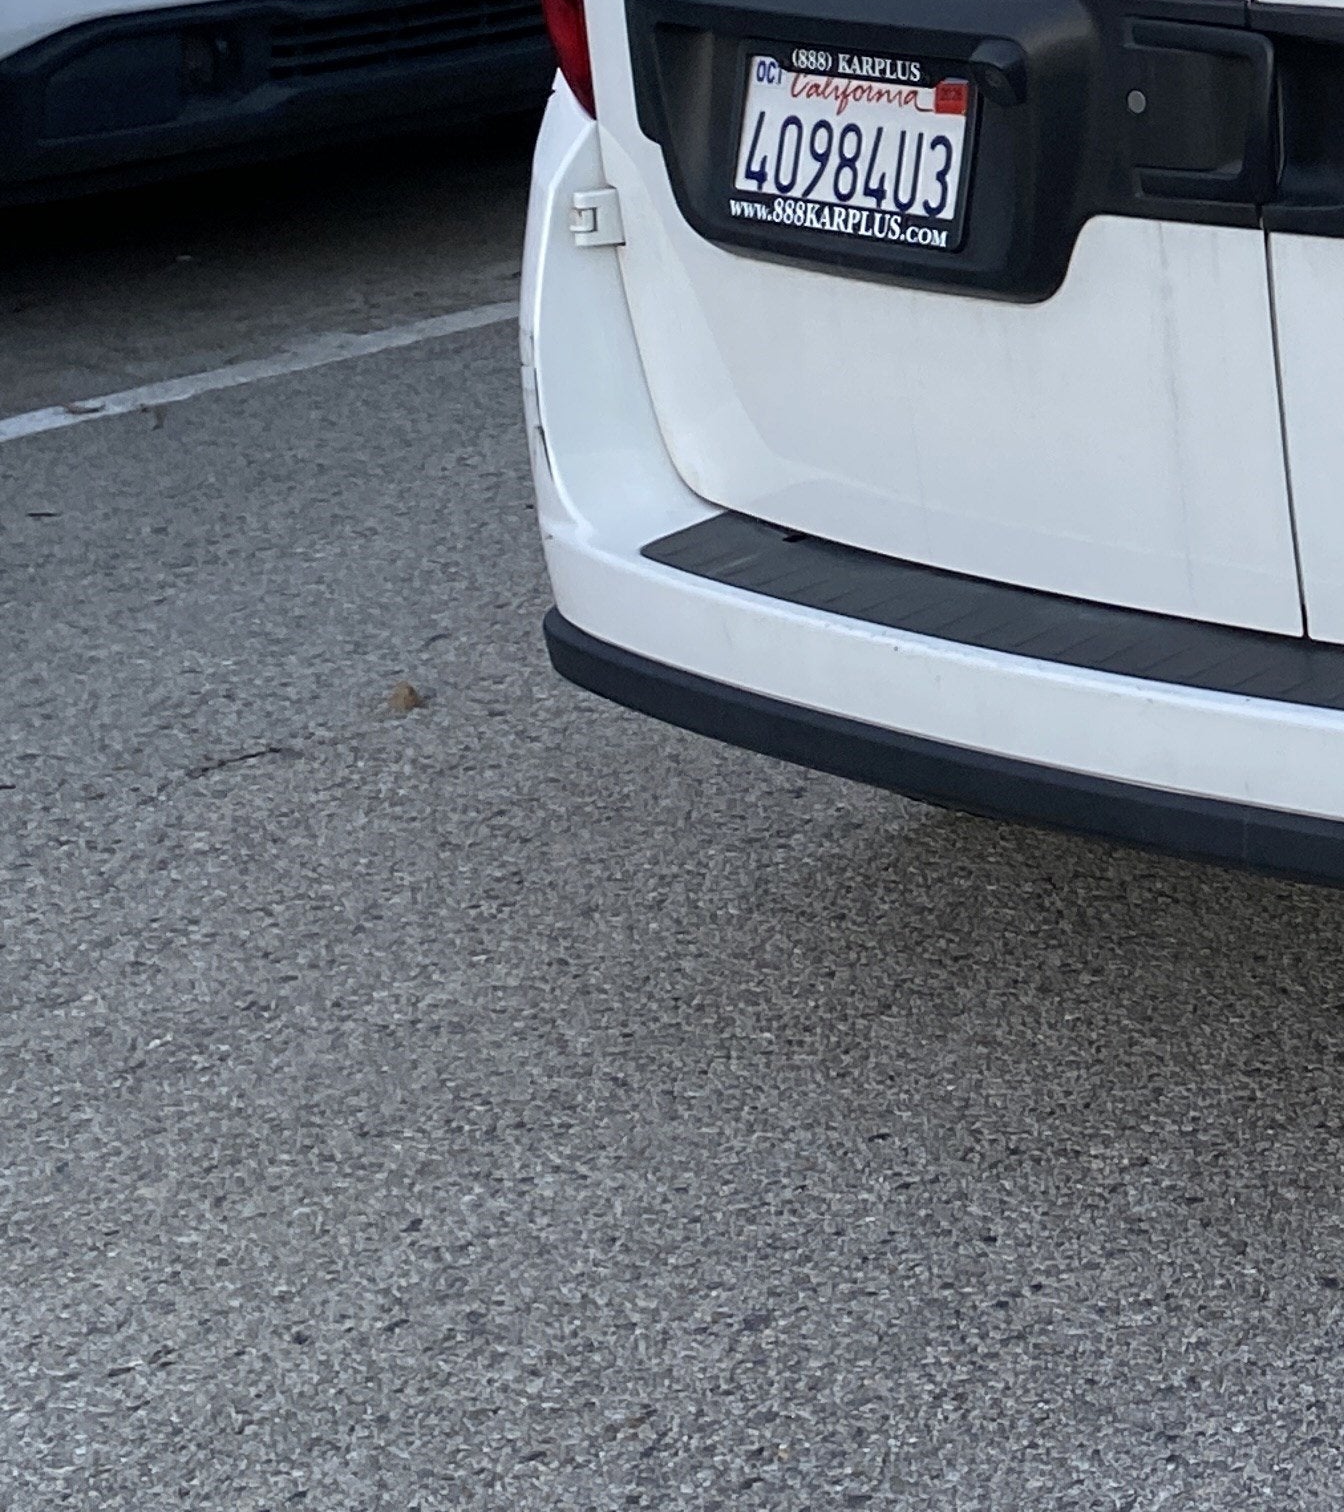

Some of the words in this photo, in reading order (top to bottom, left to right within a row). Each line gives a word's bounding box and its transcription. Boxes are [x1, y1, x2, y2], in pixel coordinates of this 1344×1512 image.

[791, 49, 832, 71] (888)
[838, 54, 922, 81] KARPLUS
[791, 73, 934, 116] California
[745, 111, 954, 216] 40984U3
